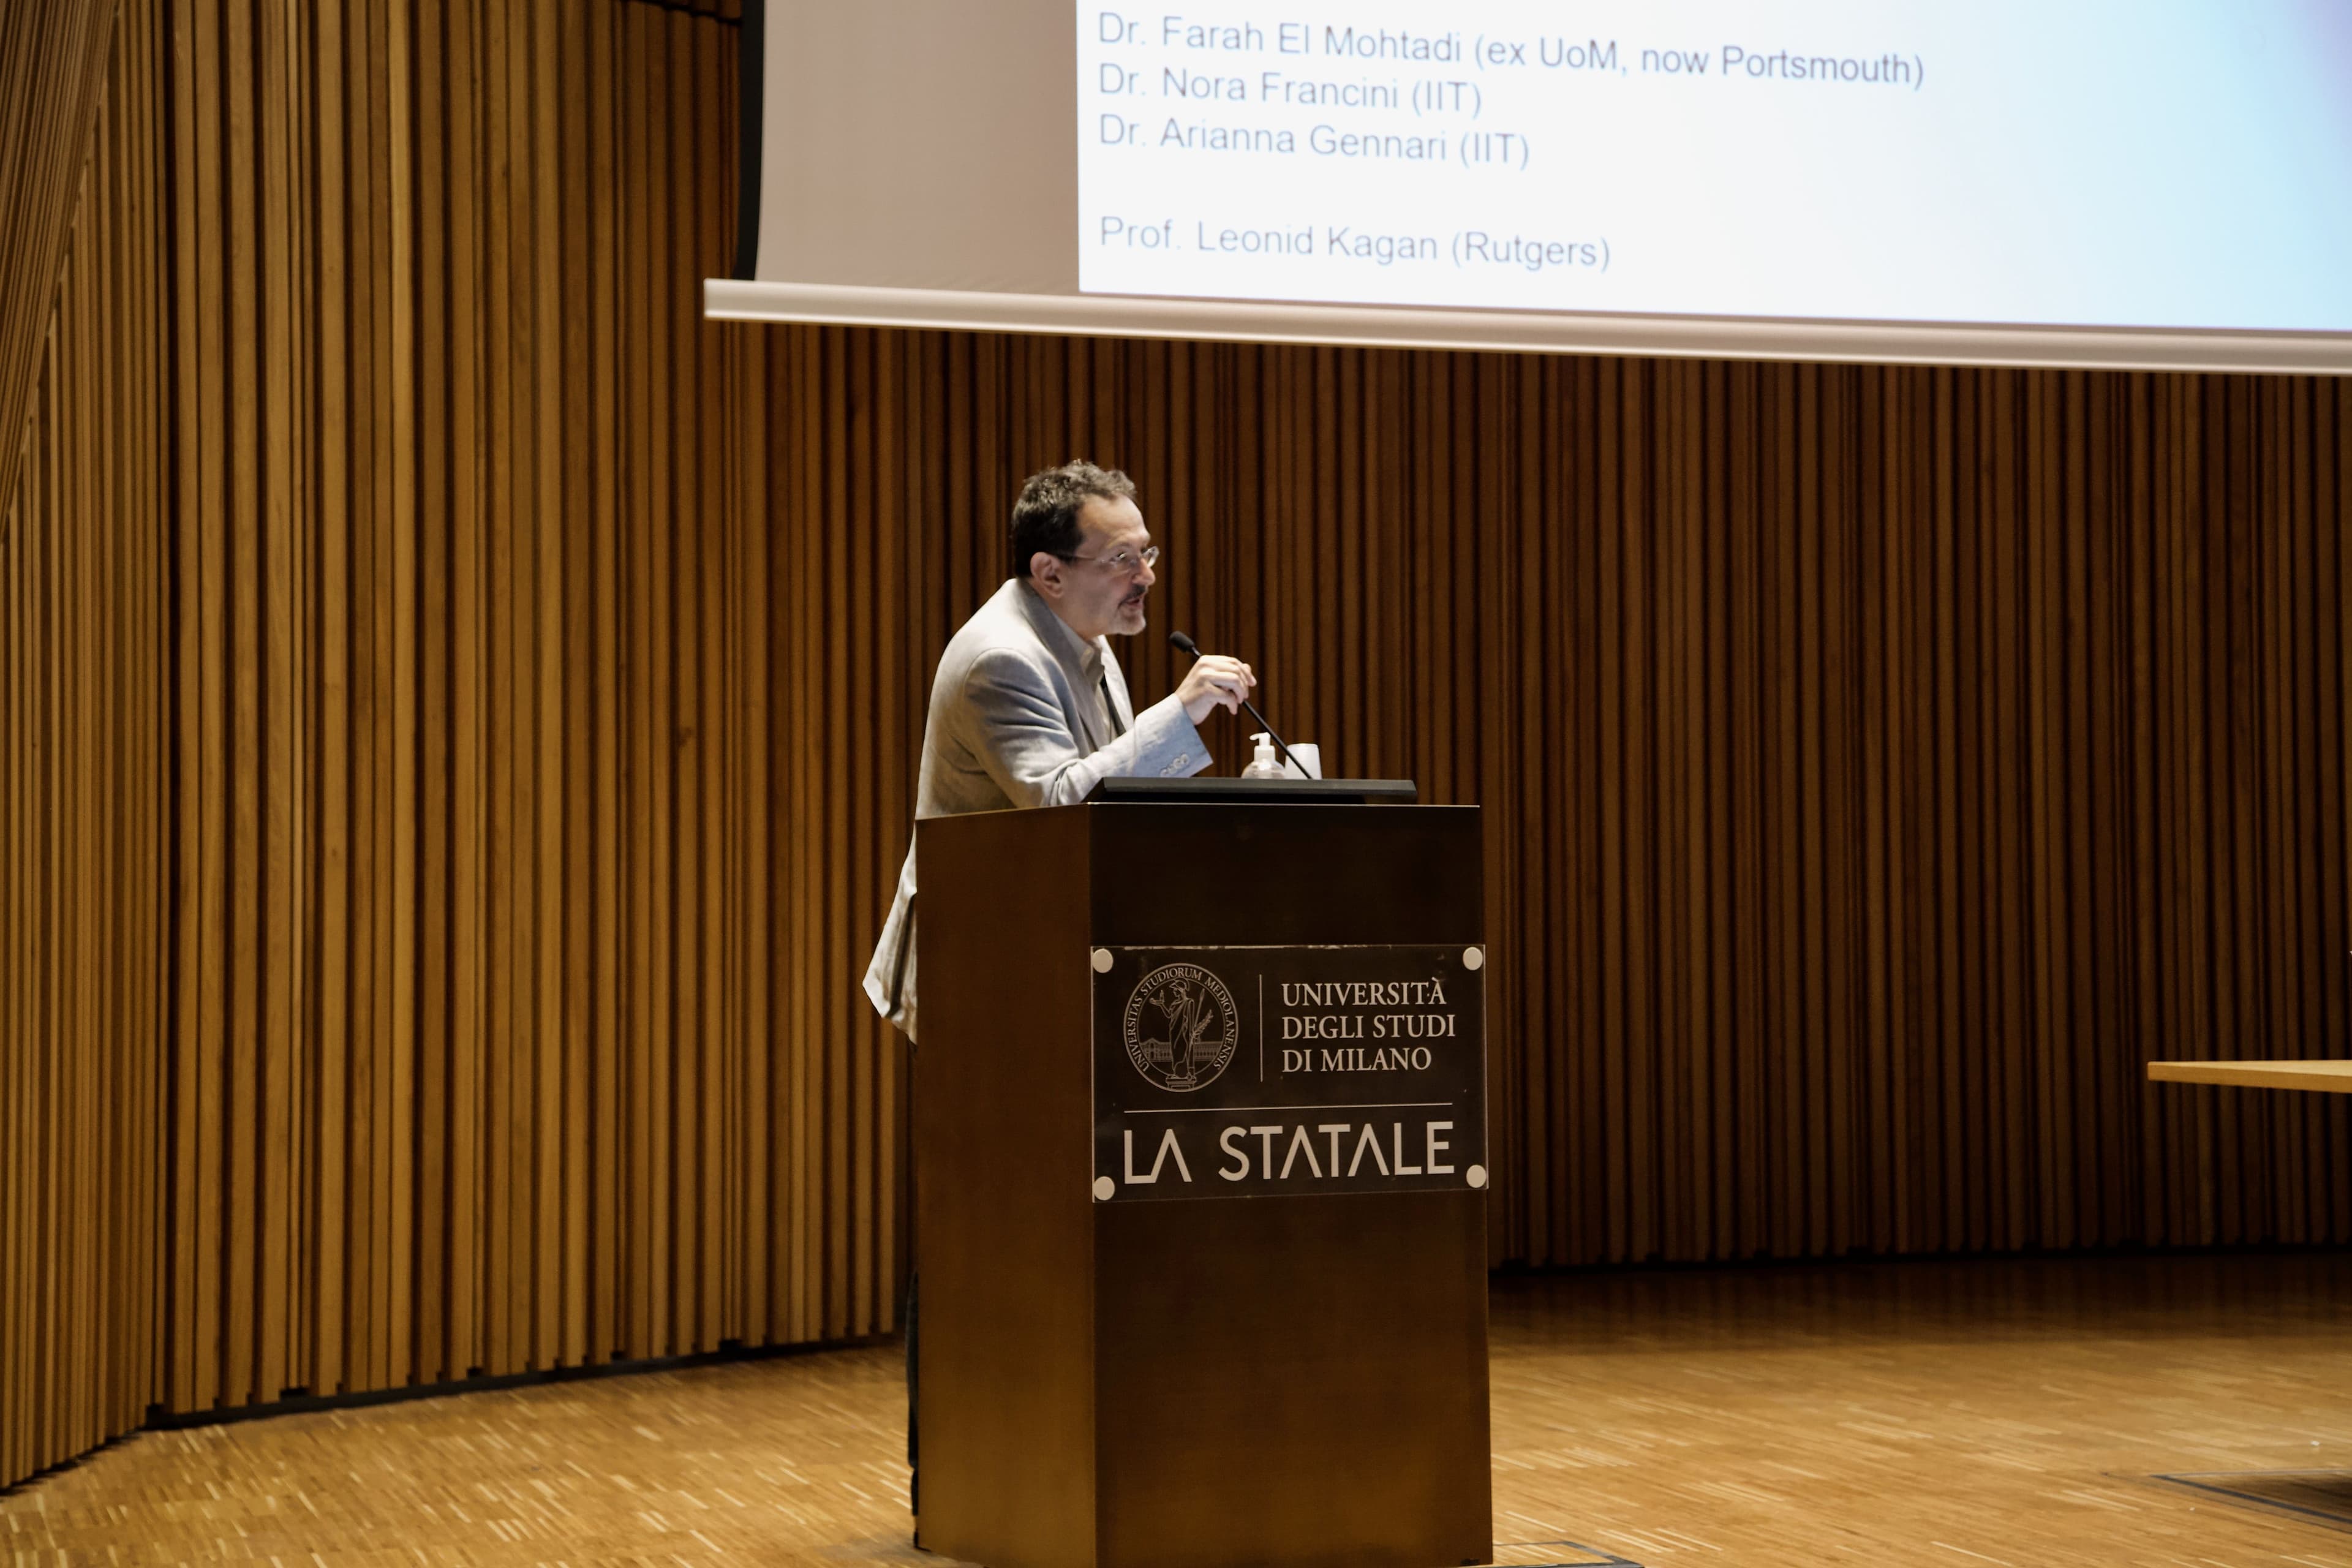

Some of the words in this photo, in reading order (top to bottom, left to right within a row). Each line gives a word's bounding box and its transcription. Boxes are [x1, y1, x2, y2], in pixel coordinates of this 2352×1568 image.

[1100, 12, 1145, 44] Dr.
[1163, 16, 1262, 50] Farah
[1280, 23, 1309, 53] El
[1325, 25, 1460, 61] Mohtadi
[1476, 37, 1525, 69] (ex
[1540, 37, 1626, 74] UoM,
[1643, 50, 1708, 74] now
[1723, 45, 1923, 91] Portsmouth)
[1101, 63, 1145, 93] Dr.
[1164, 67, 1245, 100] Nora
[1262, 72, 1396, 108] Francini
[1413, 81, 1481, 118] (IIT)
[1101, 114, 1145, 144] Dr.
[1160, 118, 1294, 153] Arianna
[1310, 125, 1445, 159] Gennari
[1461, 133, 1528, 170] (IIT)
[1102, 216, 1178, 248] Prof.
[1199, 221, 1312, 254] Leonid
[1329, 227, 1436, 265] Kagan
[1453, 232, 1609, 271] (Rutgers)
[1281, 977, 1447, 1006] UNIVERSITÀ
[1127, 997, 1150, 1072] UNIVERSITAS
[1140, 967, 1202, 995] STUDIORUM
[1204, 977, 1235, 1069] MEDIOLANENSIS
[1282, 1016, 1363, 1039] DEGLI
[1373, 1015, 1455, 1038] STUDI
[1283, 1050, 1312, 1072] DI
[1321, 1047, 1431, 1071] MILANO
[1124, 1129, 1192, 1184] LA
[1219, 1121, 1454, 1181] STATALE
